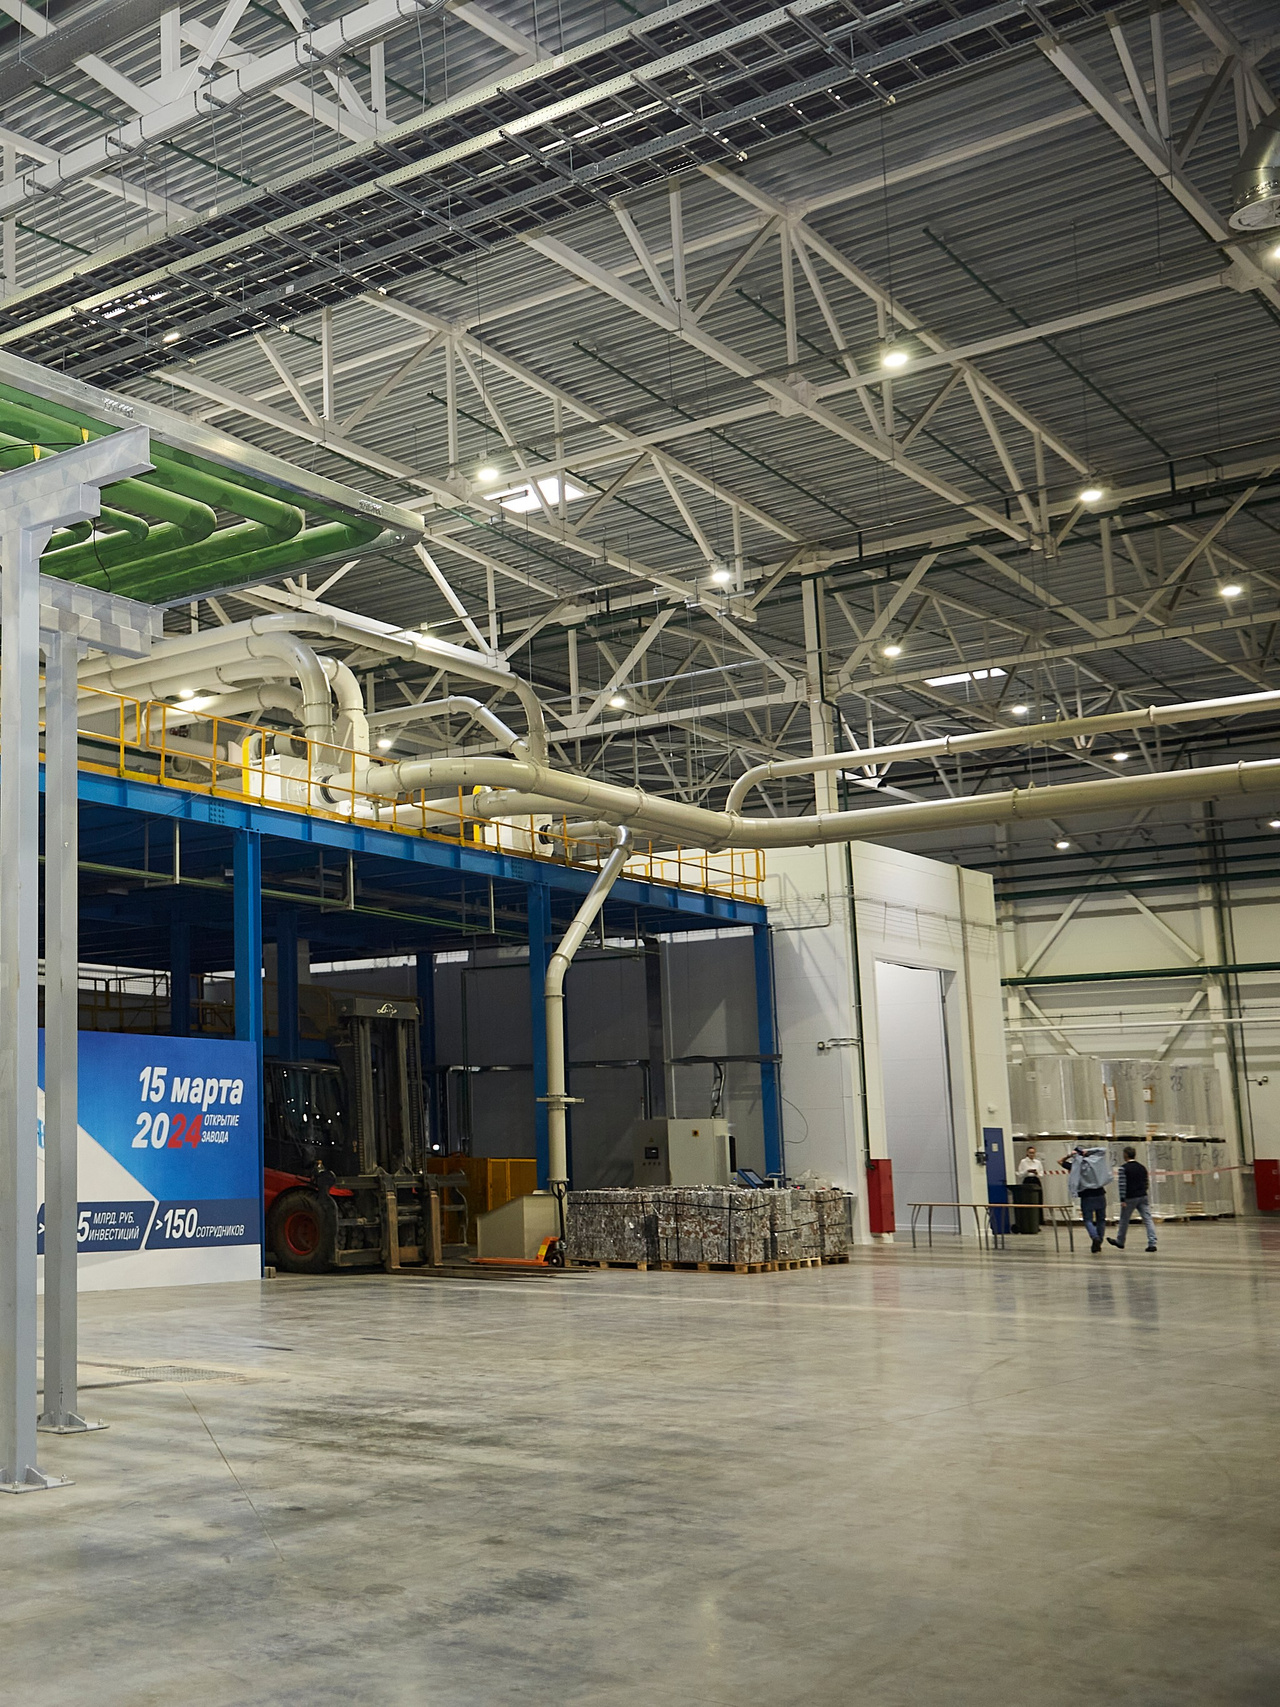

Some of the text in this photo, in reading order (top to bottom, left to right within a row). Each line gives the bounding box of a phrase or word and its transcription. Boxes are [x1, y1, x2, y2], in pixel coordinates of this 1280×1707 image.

[139, 1066, 244, 1112] 15 марта
[204, 1114, 240, 1126] ОТКРЫТИЕ
[131, 1112, 203, 1149] 2024
[201, 1131, 229, 1144] ЗАВОДА
[93, 1211, 135, 1225] МЛРД. РУБ.
[88, 1226, 140, 1241] ИНВЕСТИЦИЙ
[196, 1224, 245, 1238] СОТРУДНИКОВ
